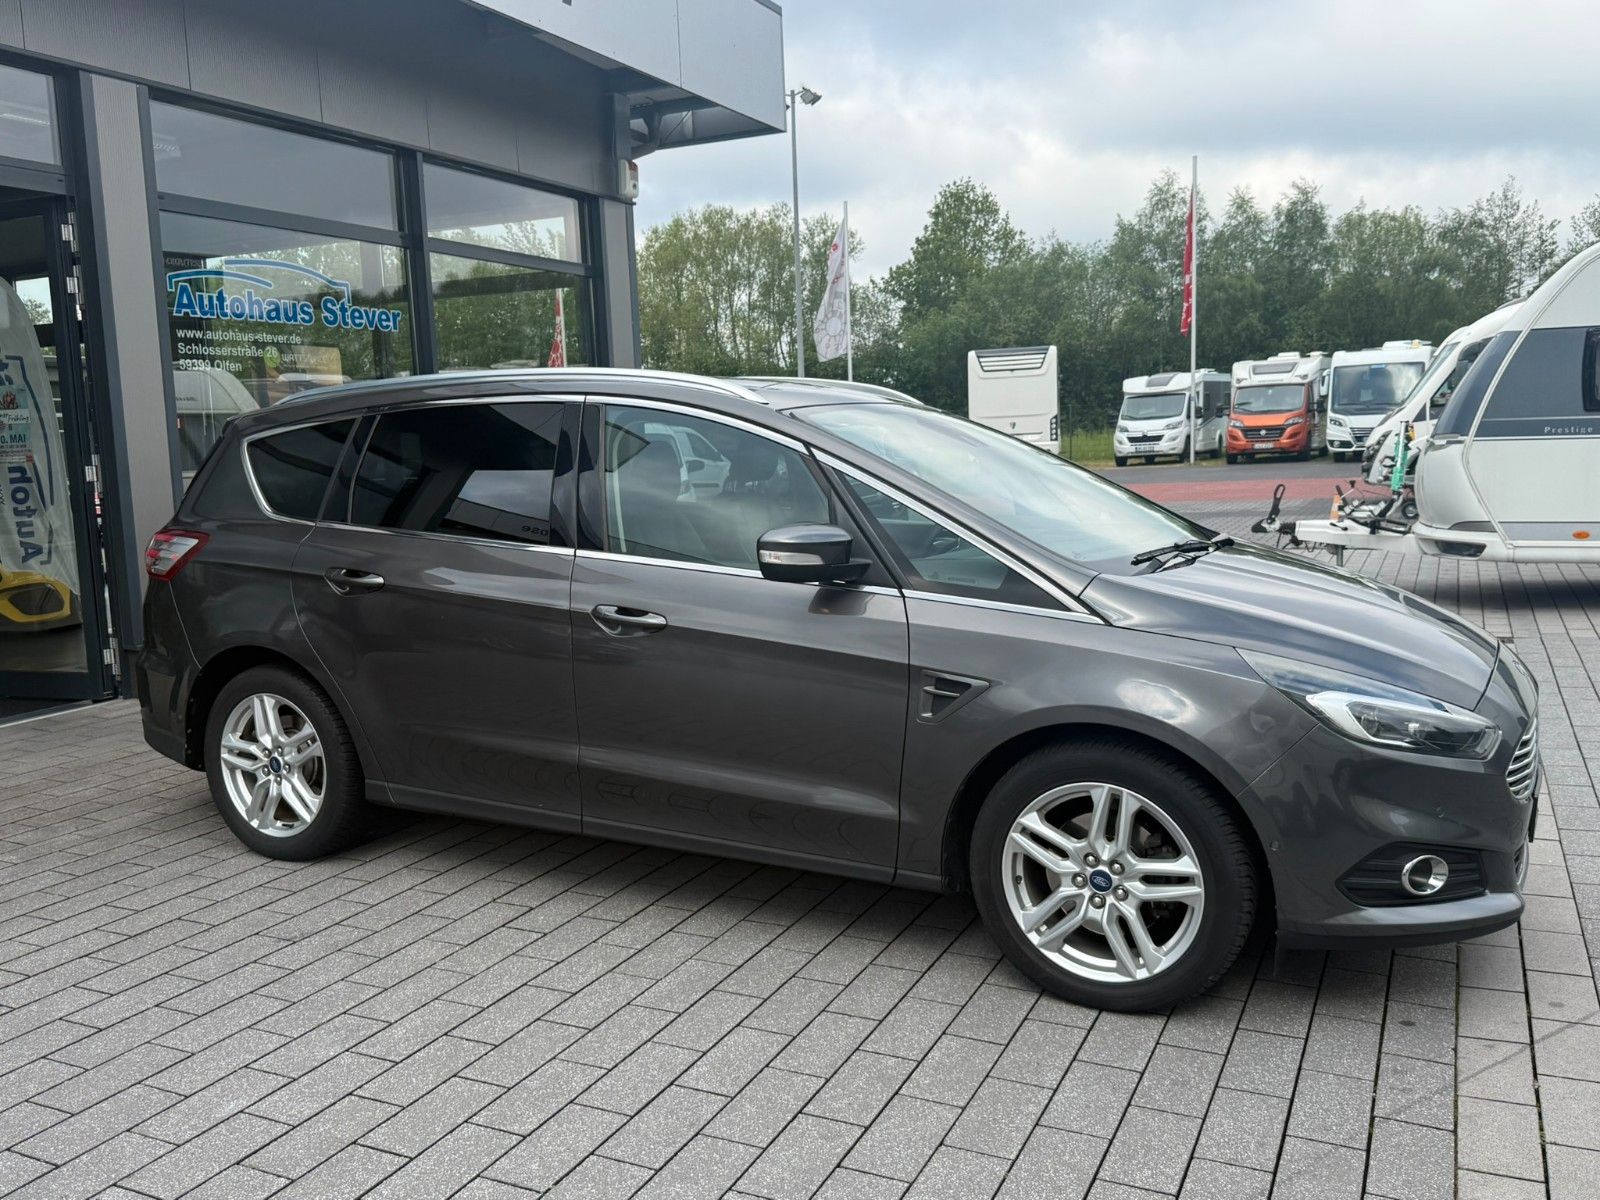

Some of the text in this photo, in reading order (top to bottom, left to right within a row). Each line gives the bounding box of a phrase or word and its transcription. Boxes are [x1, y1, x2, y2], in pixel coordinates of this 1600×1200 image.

[173, 282, 401, 332] Autohaus Stever
[176, 328, 302, 345] www.autohaus-stever.de
[177, 342, 278, 358] Schlosserstraße 26
[179, 358, 243, 372] 59399 Olfen
[1544, 426, 1593, 434] Prestige
[10, 433, 26, 444] MAI
